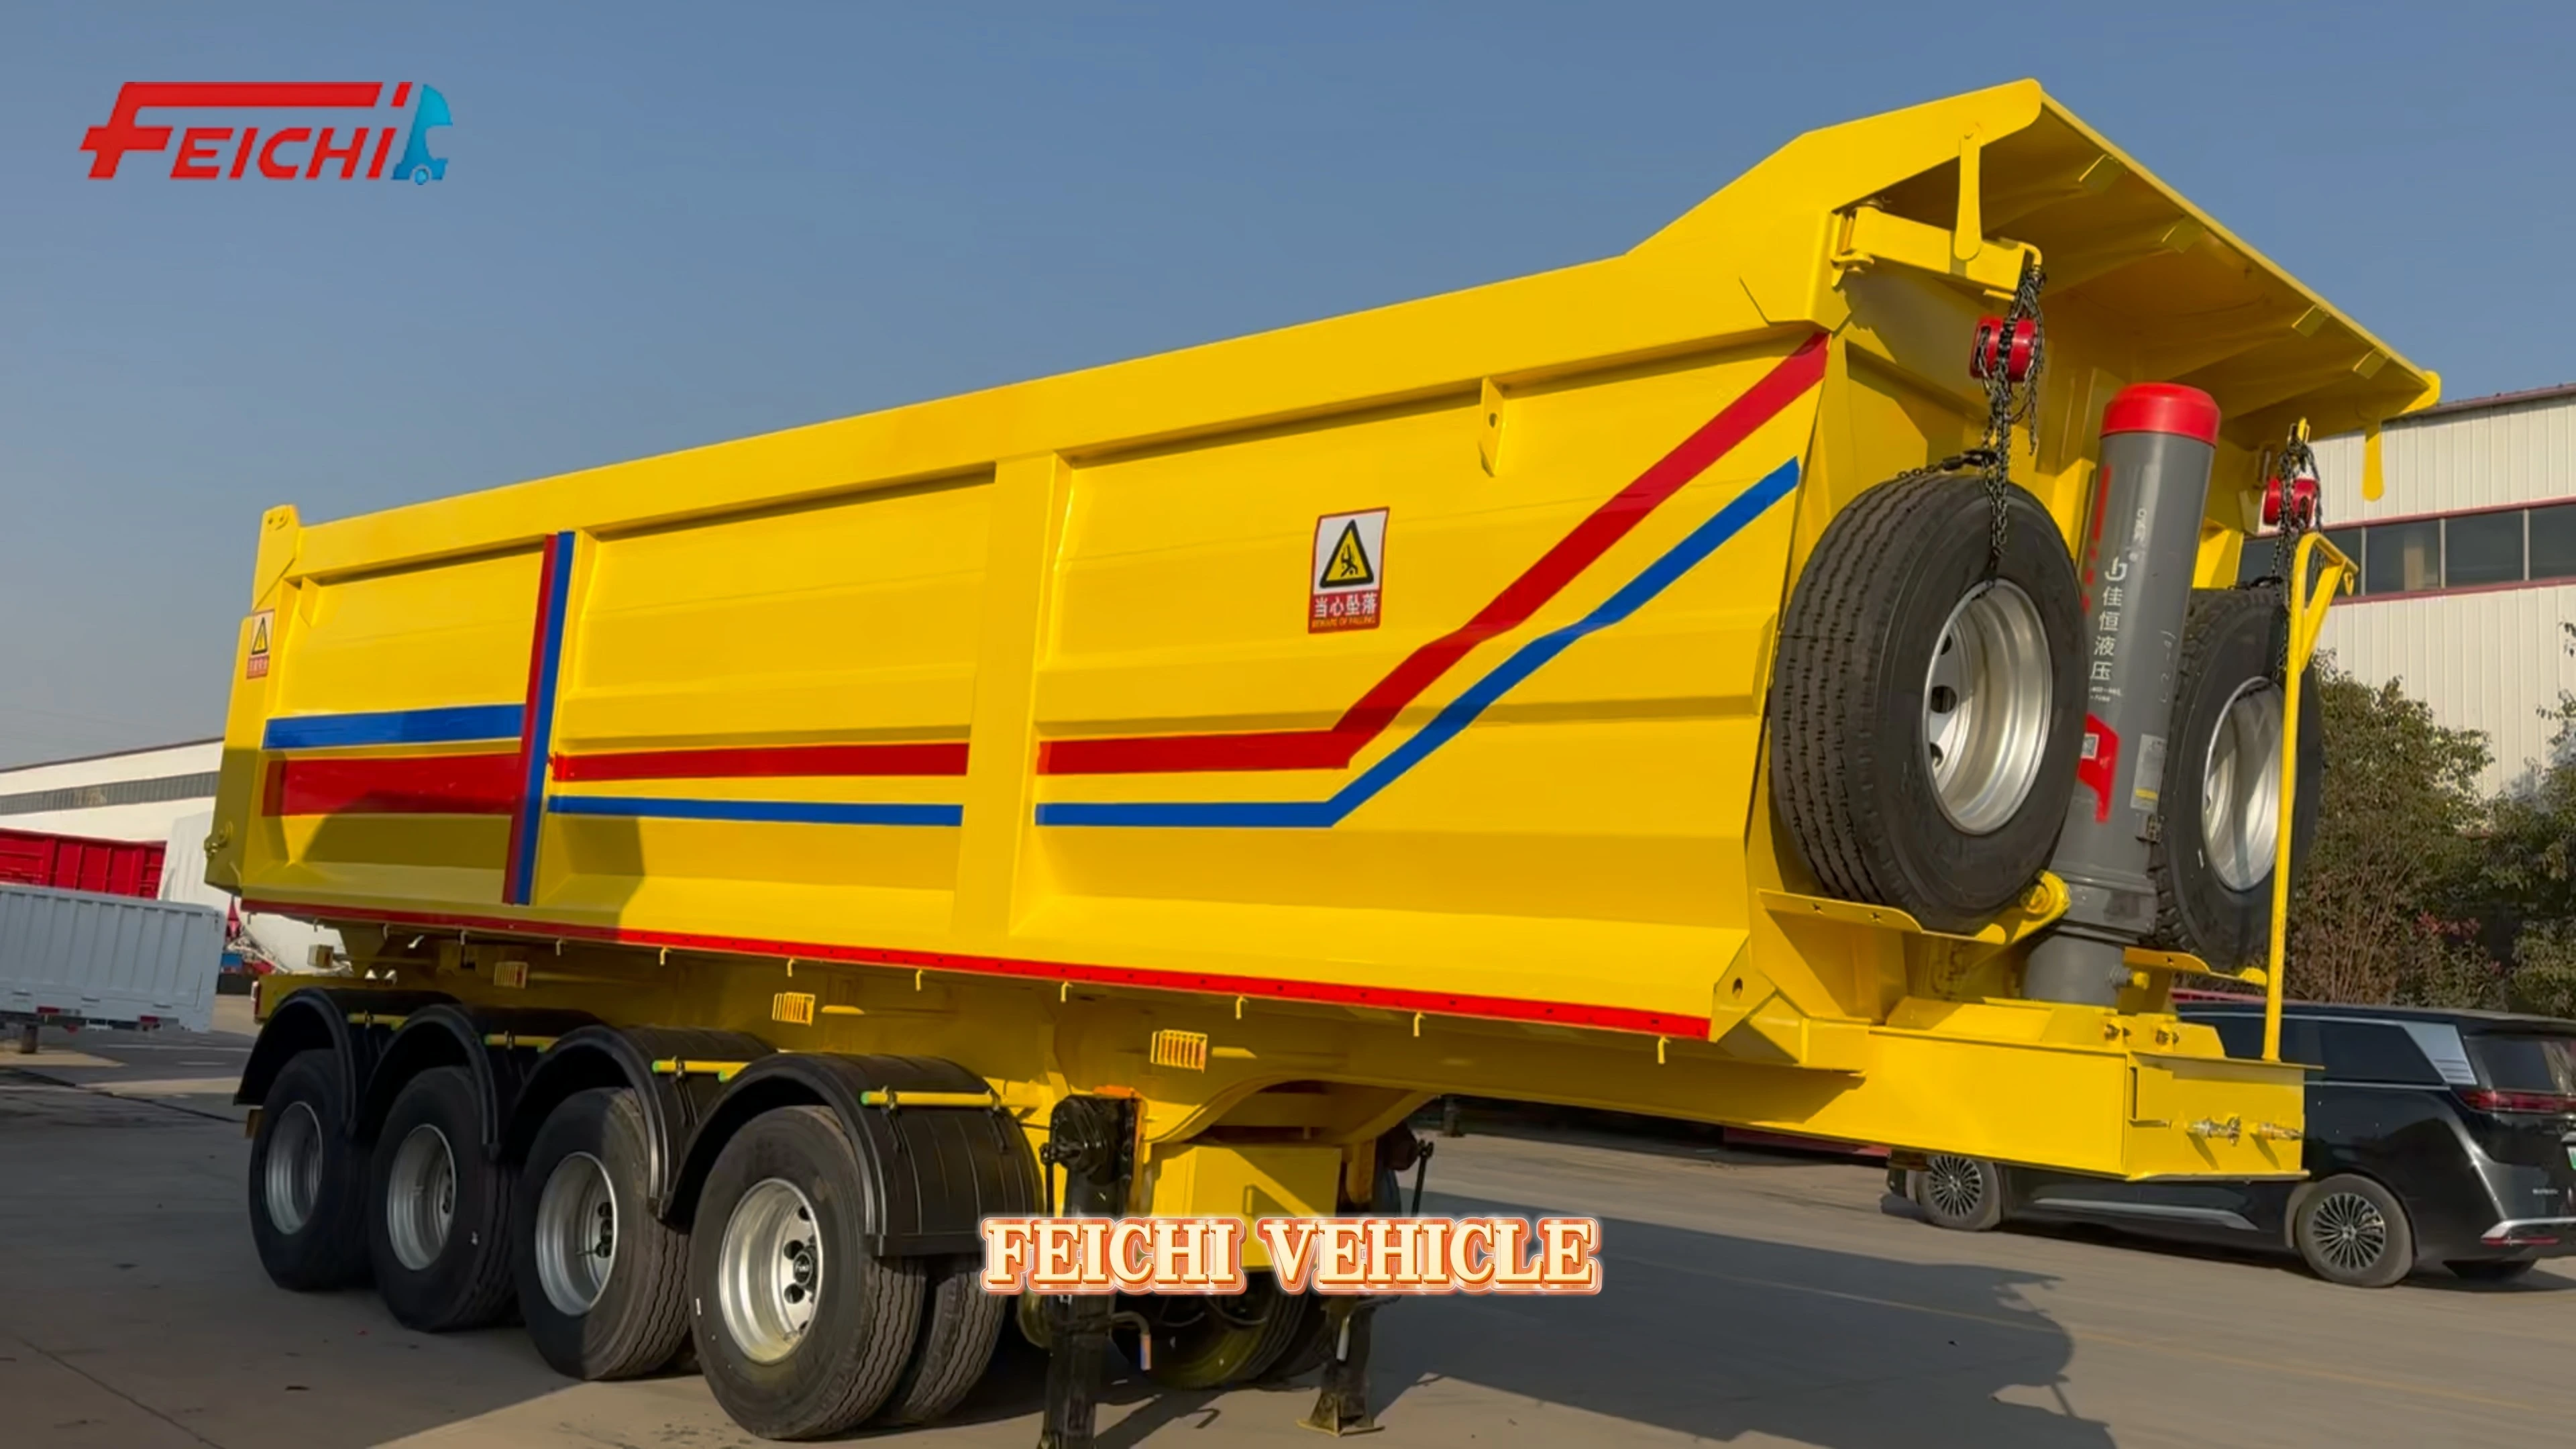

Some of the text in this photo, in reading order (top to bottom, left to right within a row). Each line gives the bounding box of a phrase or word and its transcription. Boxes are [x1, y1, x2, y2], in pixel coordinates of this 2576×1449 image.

[1314, 592, 1377, 618] 当心坠落
[2090, 586, 2123, 680] 佳恒液压
